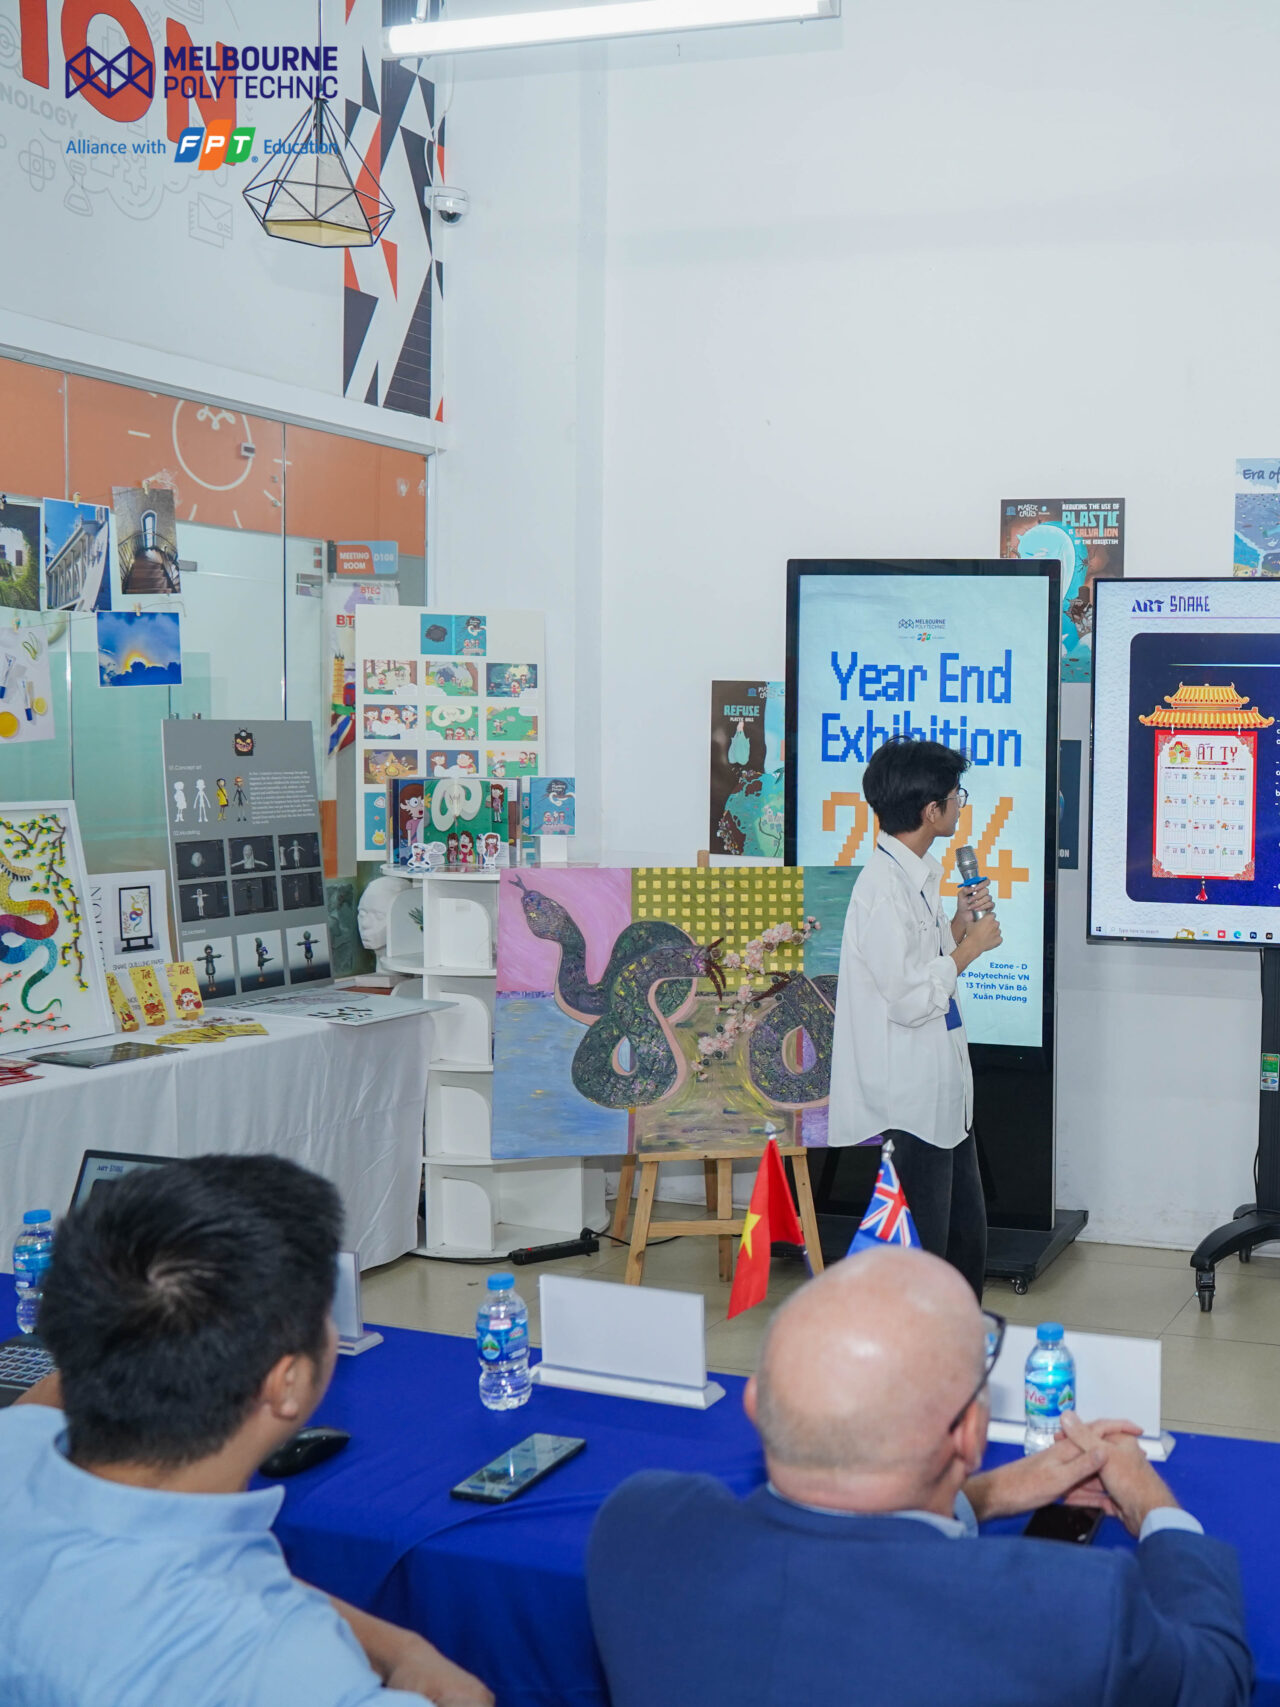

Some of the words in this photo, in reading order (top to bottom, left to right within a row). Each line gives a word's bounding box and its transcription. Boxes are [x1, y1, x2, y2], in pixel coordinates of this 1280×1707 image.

[1242, 469, 1265, 480] Era
[1061, 511, 1120, 529] PLASTIC
[339, 552, 370, 560] MEETING
[343, 561, 366, 569] ROOM
[360, 586, 381, 595] BTEC
[1132, 599, 1165, 613] ART
[1169, 595, 1211, 613] SNAKE
[336, 614, 355, 626] BT
[831, 651, 928, 702] Year
[939, 649, 1012, 704] End
[723, 704, 760, 717] REFUSE
[989, 962, 1014, 971] Ezone
[968, 971, 1016, 982] Polytechnic
[1017, 973, 1030, 981] VN
[966, 982, 974, 990] 13
